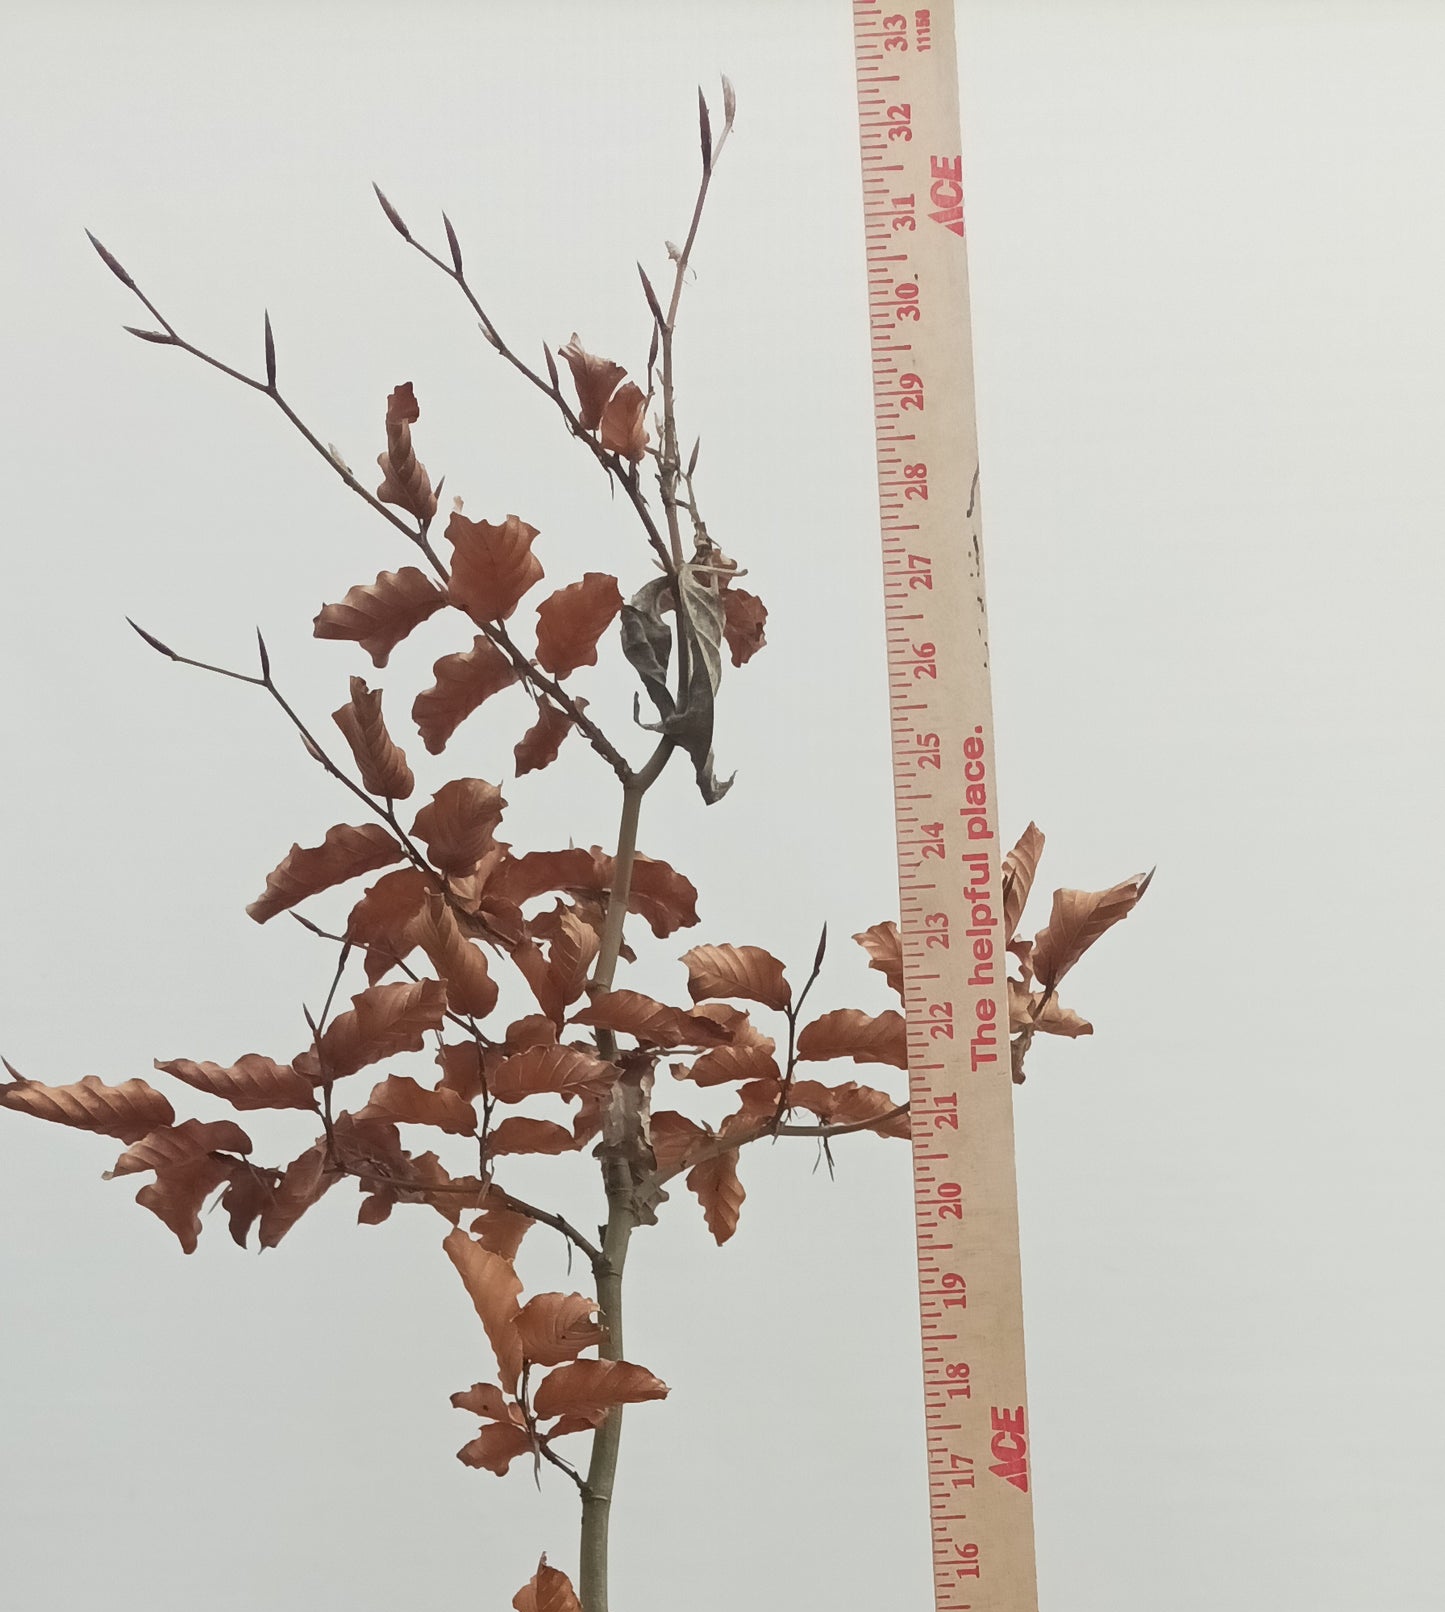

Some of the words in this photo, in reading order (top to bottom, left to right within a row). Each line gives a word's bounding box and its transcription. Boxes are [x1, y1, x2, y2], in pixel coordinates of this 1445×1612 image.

[883, 14, 907, 51] 33
[887, 104, 912, 141] 32
[891, 193, 916, 231] 31
[927, 155, 964, 237] ACE
[895, 283, 920, 321] 30
[900, 373, 924, 410] 29
[904, 463, 928, 500] 28
[908, 554, 932, 590] 27
[912, 642, 936, 679] 26
[917, 733, 940, 769] 25
[960, 725, 994, 839] place.
[921, 822, 945, 859] 24
[925, 912, 949, 949] 23
[962, 853, 998, 985] helpful
[929, 1002, 953, 1039] 22
[970, 998, 997, 1072] The
[934, 1092, 958, 1130] 21
[938, 1183, 962, 1219] 20
[941, 1273, 966, 1309] 19
[946, 1363, 970, 1399] 18
[988, 1405, 1028, 1492] ACE
[950, 1454, 974, 1489] 17
[955, 1543, 980, 1578] 16
